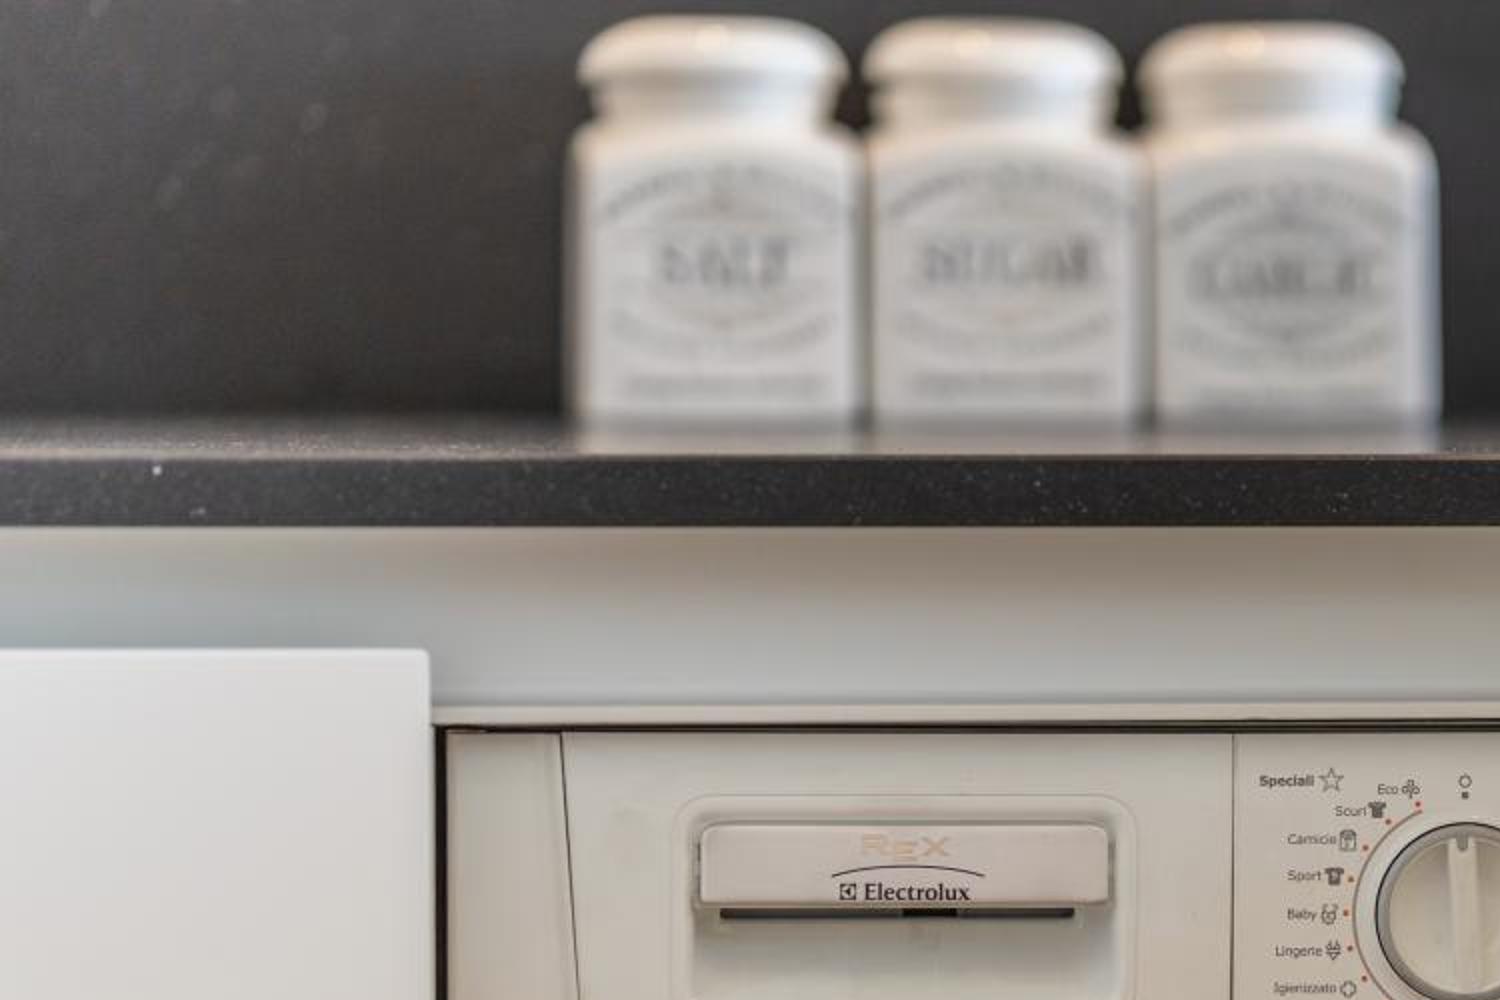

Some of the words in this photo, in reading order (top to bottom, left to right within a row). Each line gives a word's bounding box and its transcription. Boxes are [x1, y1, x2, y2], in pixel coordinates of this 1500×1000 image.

[1259, 774, 1315, 788] Speciali
[1377, 784, 1398, 795] Eco
[1335, 805, 1367, 817] Scuri
[1287, 833, 1336, 845] Camicie
[1287, 870, 1321, 883] Sport
[864, 883, 970, 901] Electrolux
[1287, 909, 1317, 922] Baby
[1275, 945, 1323, 958] Lingerie
[1273, 982, 1337, 996] Igienizzato
